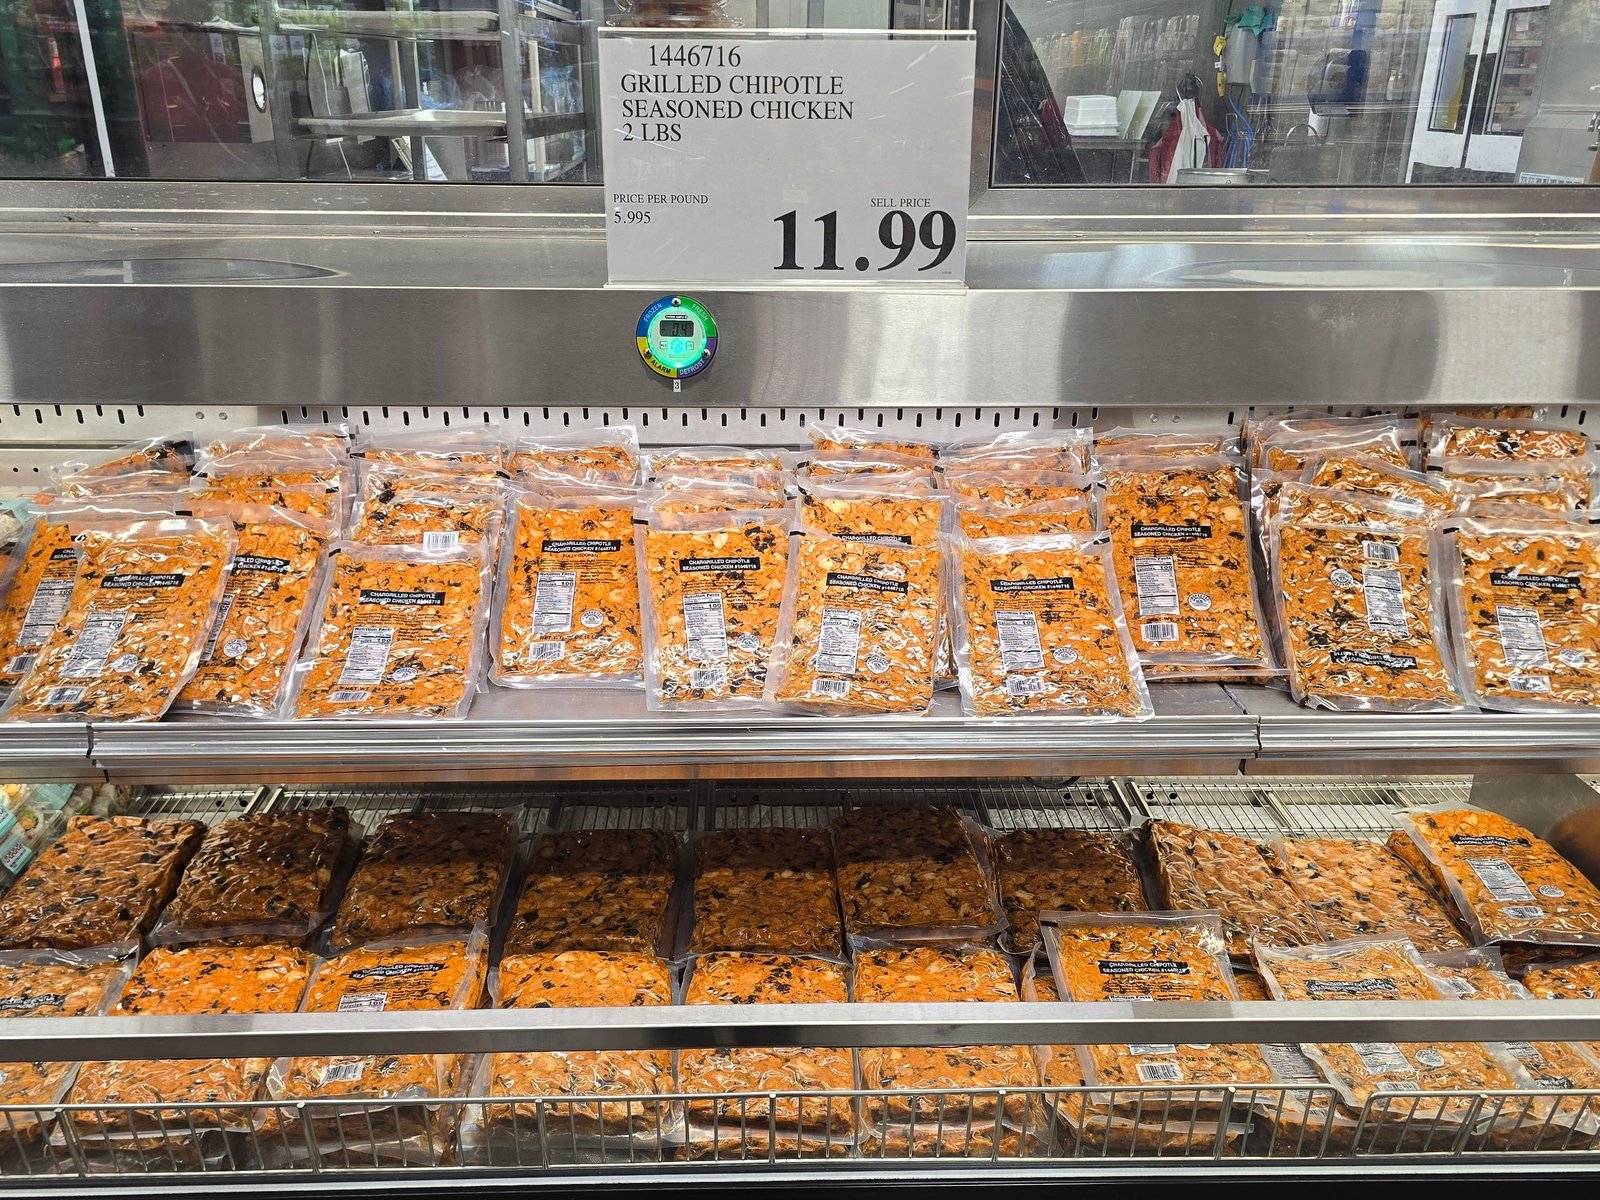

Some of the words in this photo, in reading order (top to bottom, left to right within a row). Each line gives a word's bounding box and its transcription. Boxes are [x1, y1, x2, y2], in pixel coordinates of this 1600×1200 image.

[648, 45, 741, 67] 1446716
[621, 74, 722, 94] GRILLED
[729, 75, 844, 95] CHIPOTLE
[622, 100, 742, 119] SEASONED
[750, 101, 854, 120] CHICKEN
[623, 124, 634, 142] 2
[642, 124, 682, 142] LBS
[613, 194, 644, 204] PRICE
[648, 194, 667, 204] PER
[671, 194, 708, 204] POUND
[870, 198, 896, 208] SELL
[900, 198, 931, 208] PRICE
[614, 211, 651, 224] 5.995
[773, 209, 956, 272] 11.99
[643, 302, 662, 322] FROZEN
[692, 303, 709, 321] FRESH
[650, 359, 671, 374] ALARM
[680, 359, 705, 375] DEFROST
